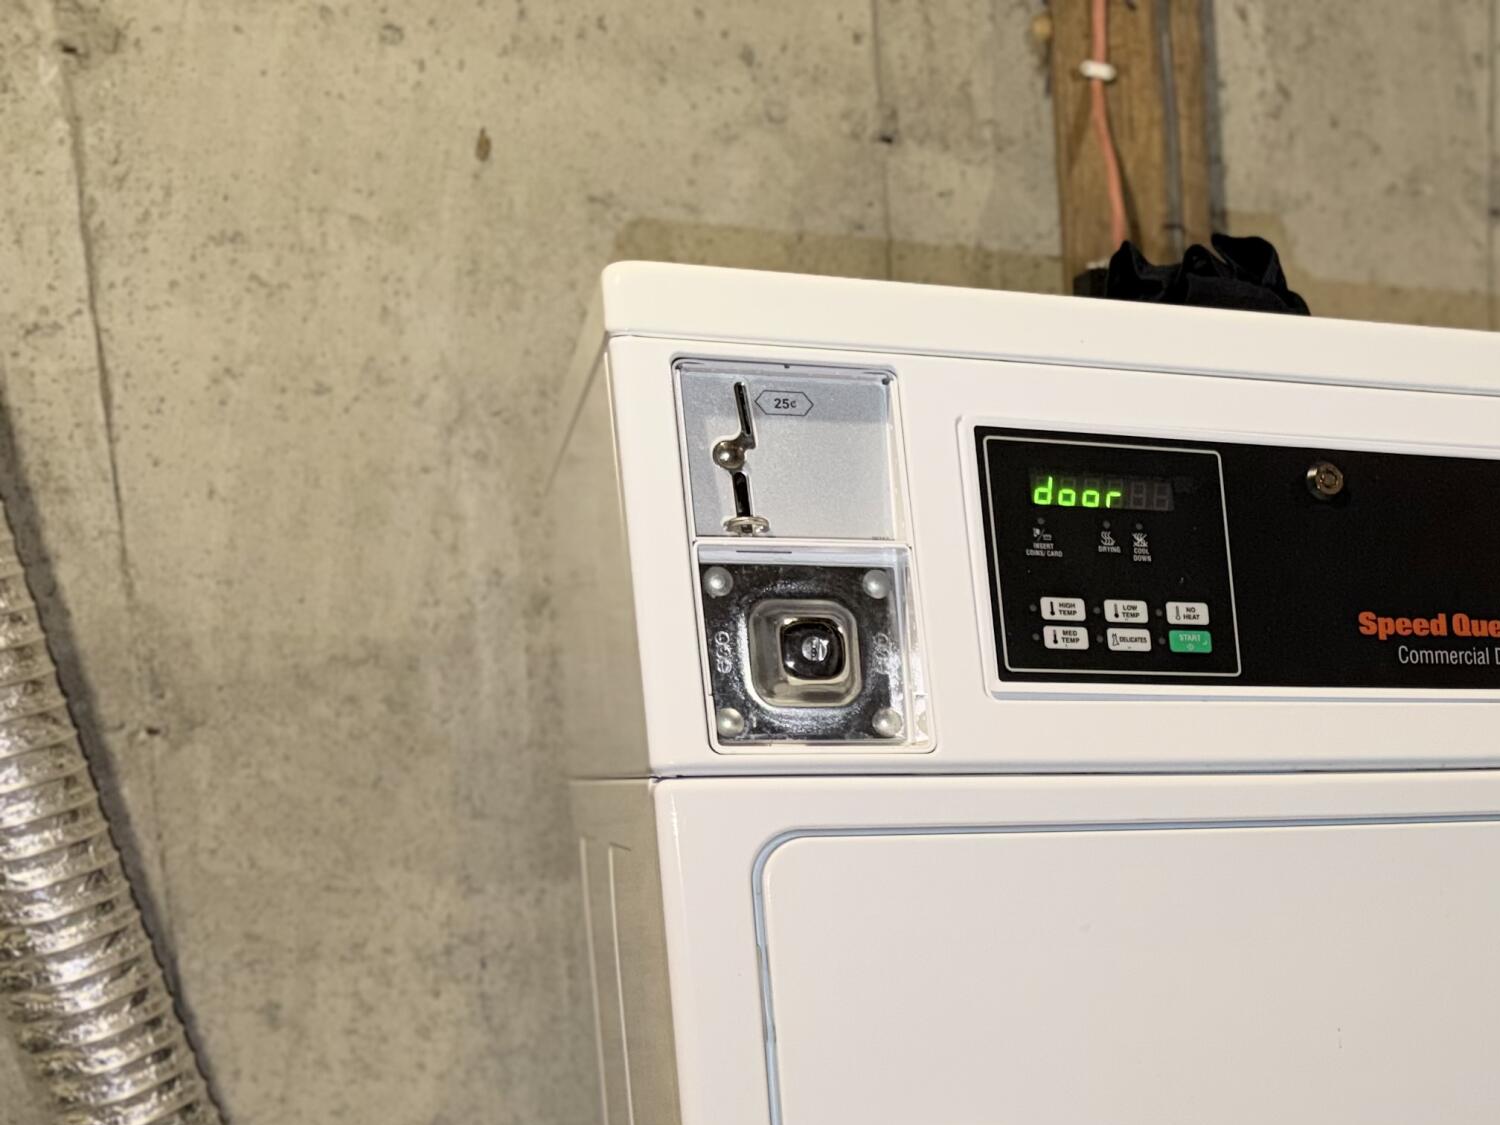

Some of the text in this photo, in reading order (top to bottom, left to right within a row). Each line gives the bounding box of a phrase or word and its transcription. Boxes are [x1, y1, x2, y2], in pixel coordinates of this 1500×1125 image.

[1033, 476, 1122, 508] door
[1098, 546, 1121, 554] DRYING
[1133, 547, 1150, 555] COOL
[1358, 611, 1448, 640] Speed
[1119, 636, 1147, 644] DELICATES
[1178, 634, 1201, 642] START
[1398, 645, 1490, 665] Commercial
